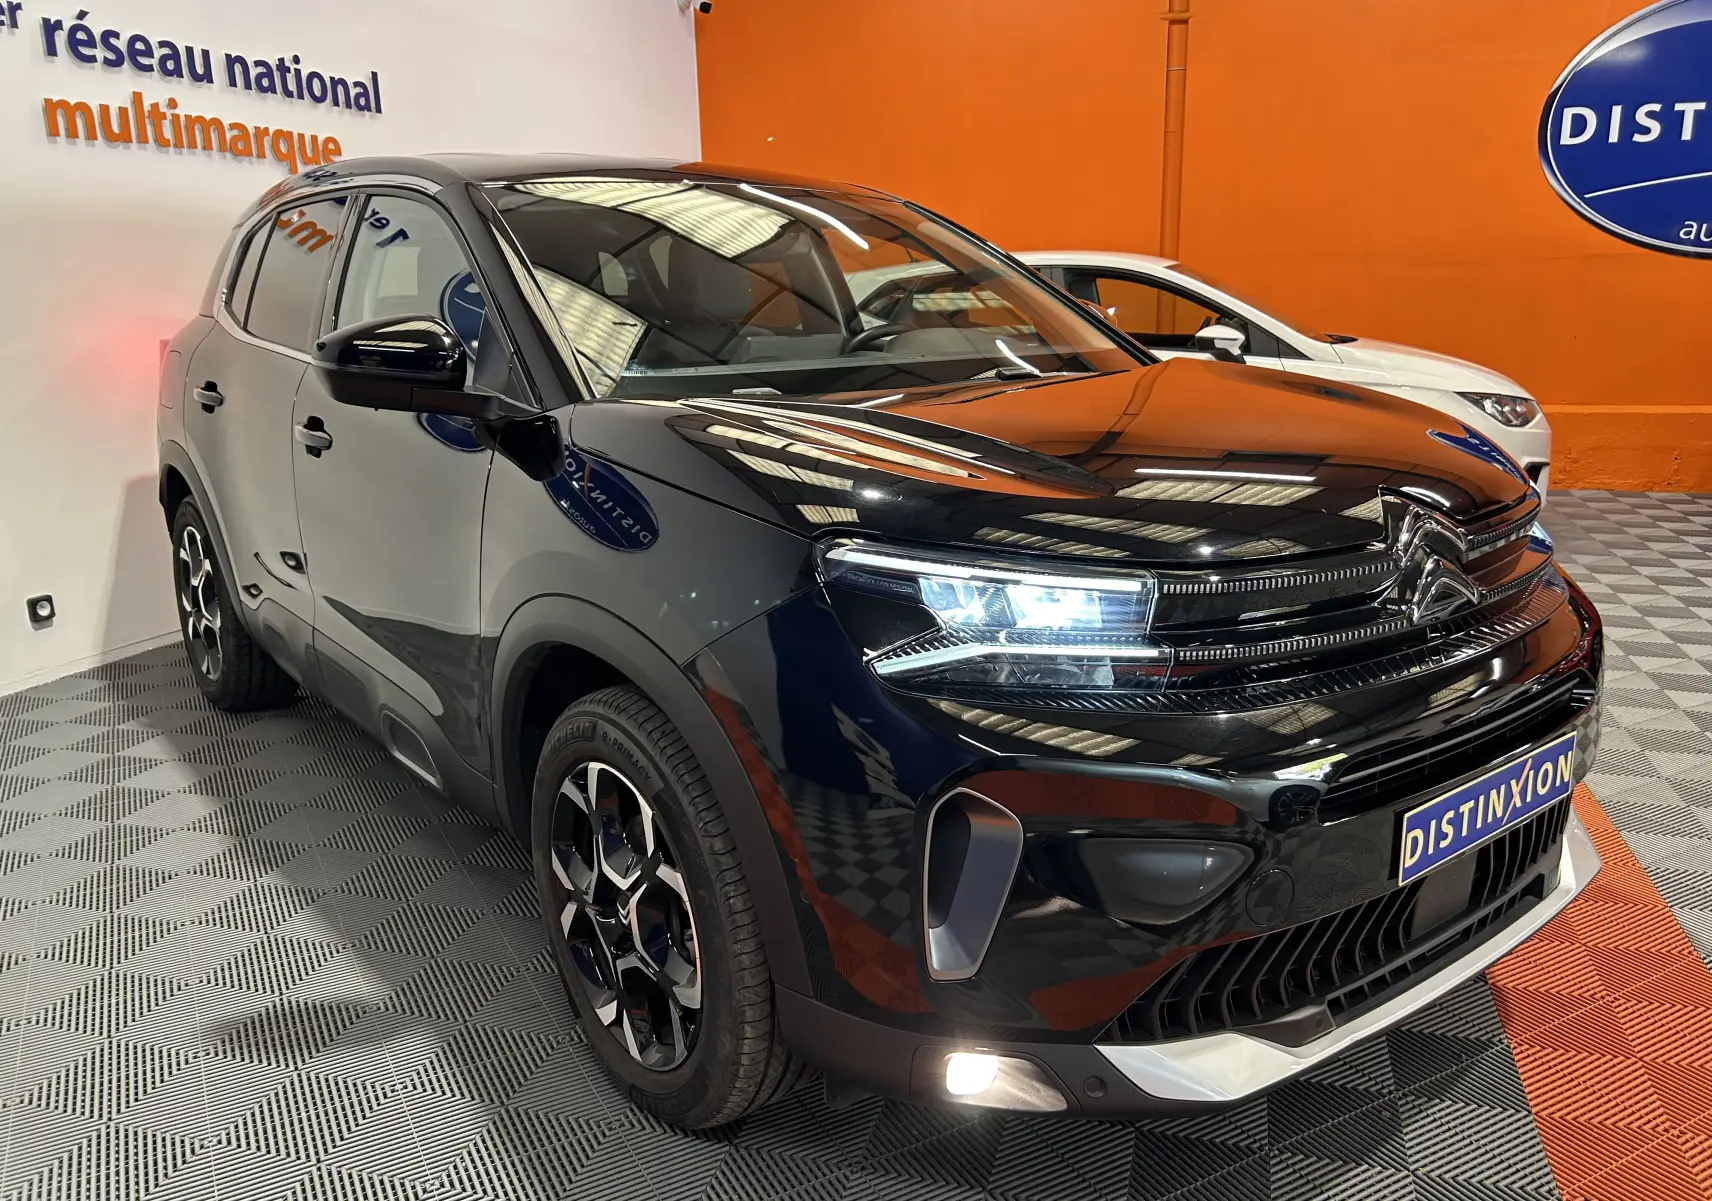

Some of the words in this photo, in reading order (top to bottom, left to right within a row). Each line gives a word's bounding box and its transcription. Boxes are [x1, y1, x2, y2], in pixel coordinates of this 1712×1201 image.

[41, 9, 213, 84] réseau
[224, 53, 382, 114] national
[43, 91, 342, 174] multimarque
[1559, 102, 1706, 145] DIST
[1404, 751, 1572, 868] DISTINXION
